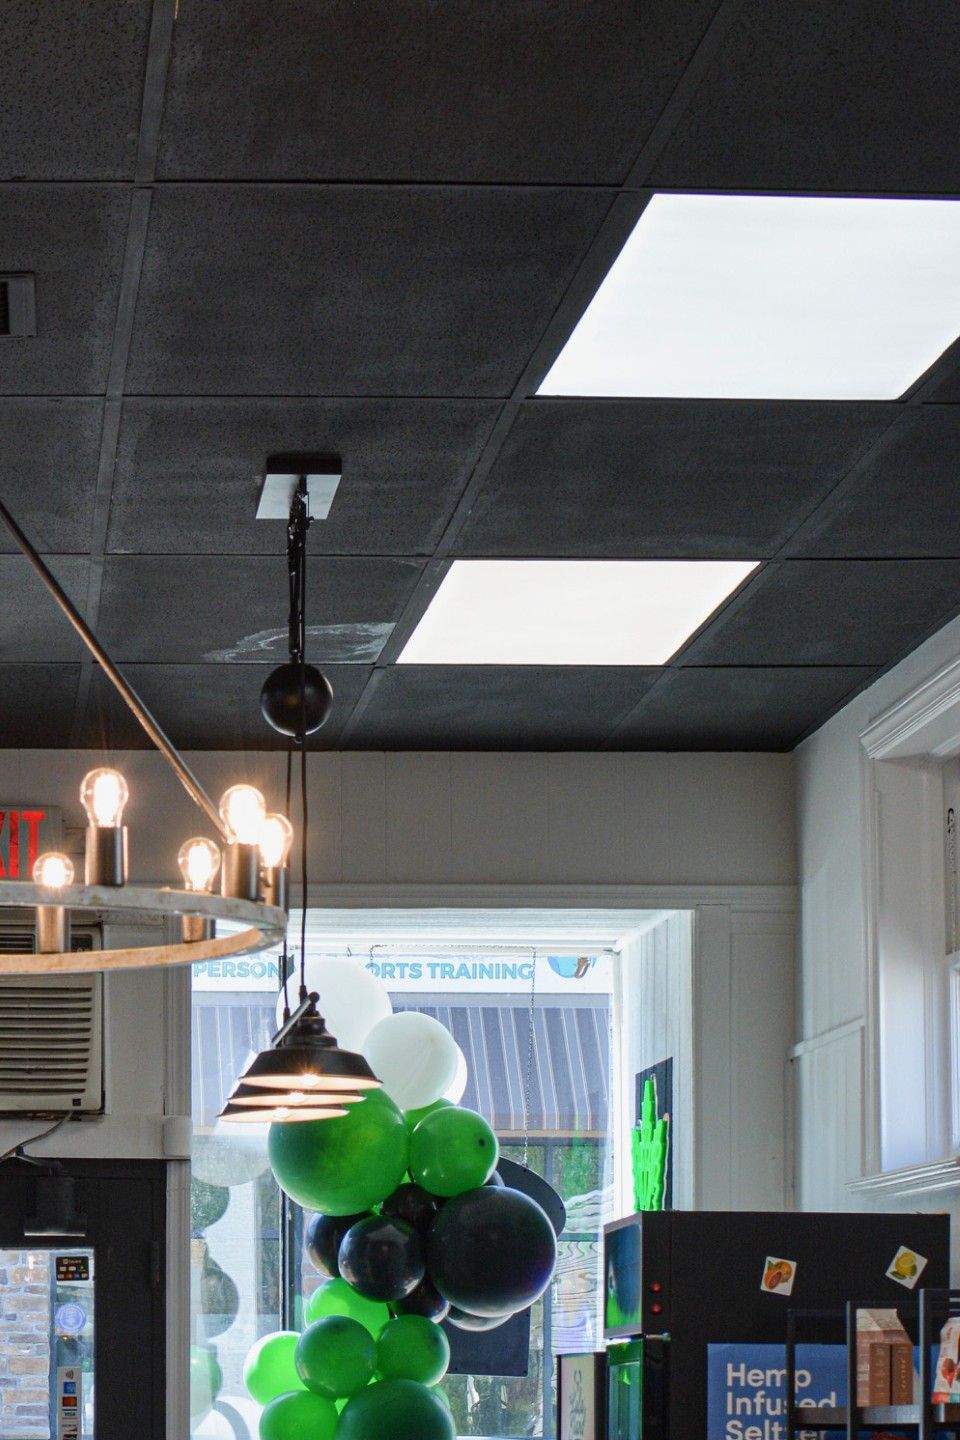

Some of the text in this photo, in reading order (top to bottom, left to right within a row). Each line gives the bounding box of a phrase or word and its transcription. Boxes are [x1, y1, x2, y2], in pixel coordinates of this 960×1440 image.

[193, 961, 280, 979] PERSON
[365, 962, 534, 980] ORTS TRAINING
